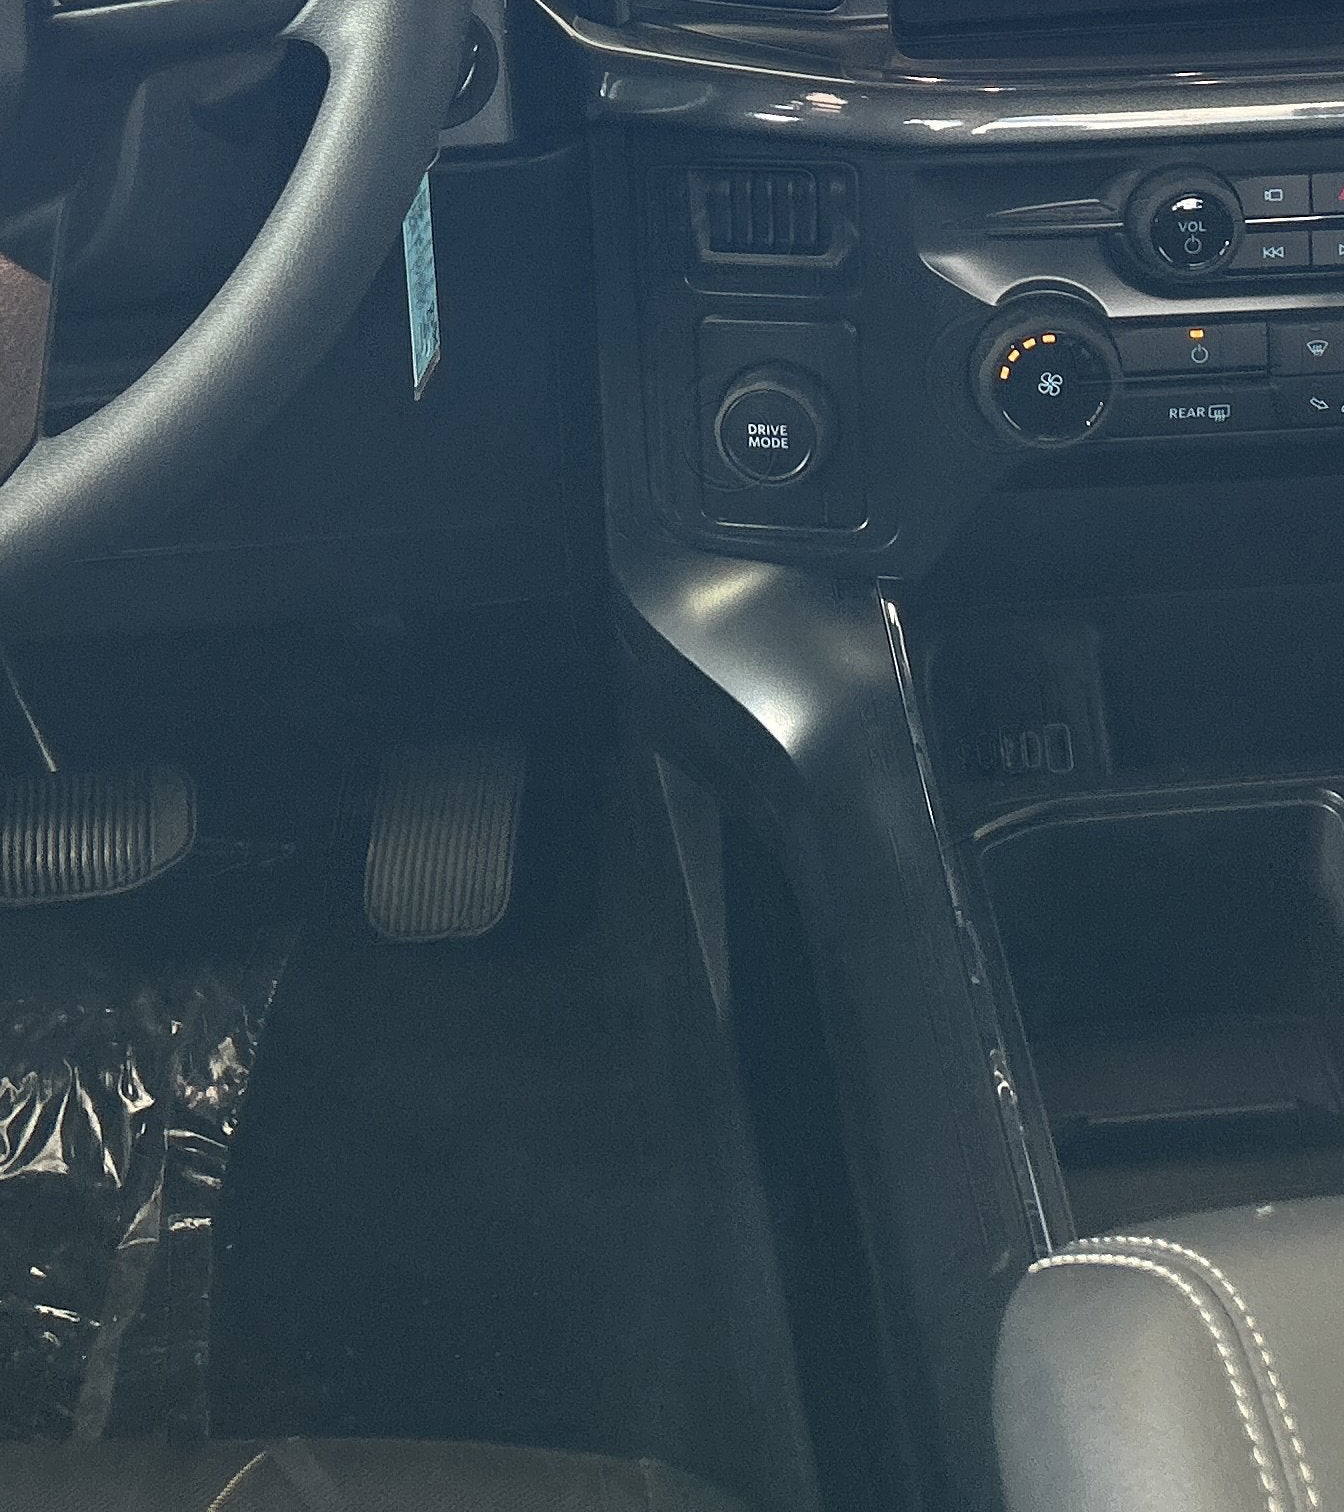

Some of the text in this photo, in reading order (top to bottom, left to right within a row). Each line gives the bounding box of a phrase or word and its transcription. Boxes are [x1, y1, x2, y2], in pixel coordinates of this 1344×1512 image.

[1178, 221, 1206, 233] VOL
[1169, 407, 1205, 419] REAR
[748, 423, 788, 436] DRIVE
[748, 436, 788, 449] MODE
